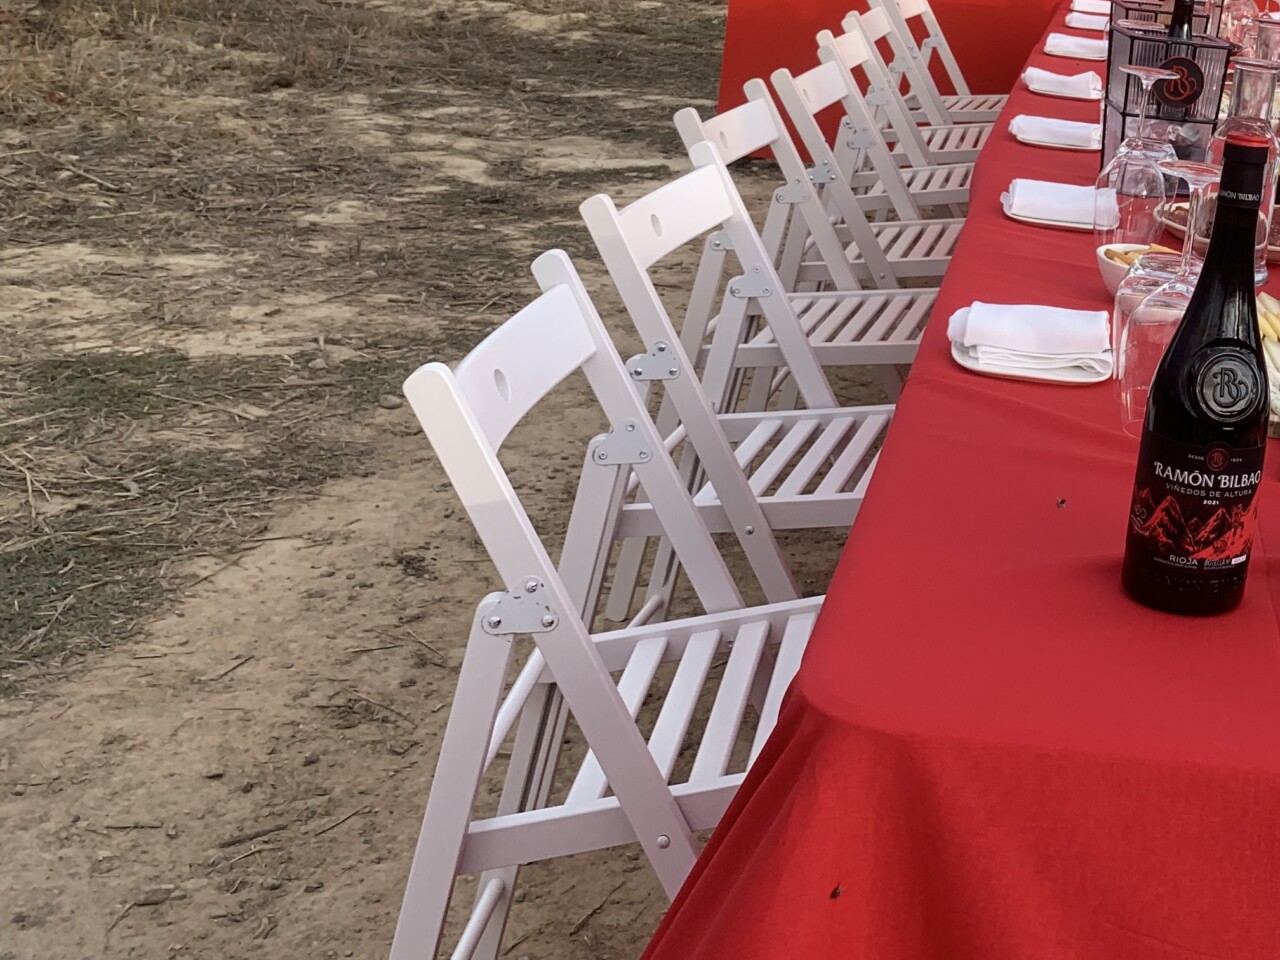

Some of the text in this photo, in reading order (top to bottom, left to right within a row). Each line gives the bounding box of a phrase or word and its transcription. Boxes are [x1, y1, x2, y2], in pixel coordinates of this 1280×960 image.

[1219, 189, 1260, 202] AMÓN BILBAO
[1153, 460, 1261, 488] RAMÓN BILBAO
[1165, 482, 1206, 497] VIÑEDOS
[1223, 488, 1252, 498] ALTURA
[1169, 554, 1198, 566] RIOJA
